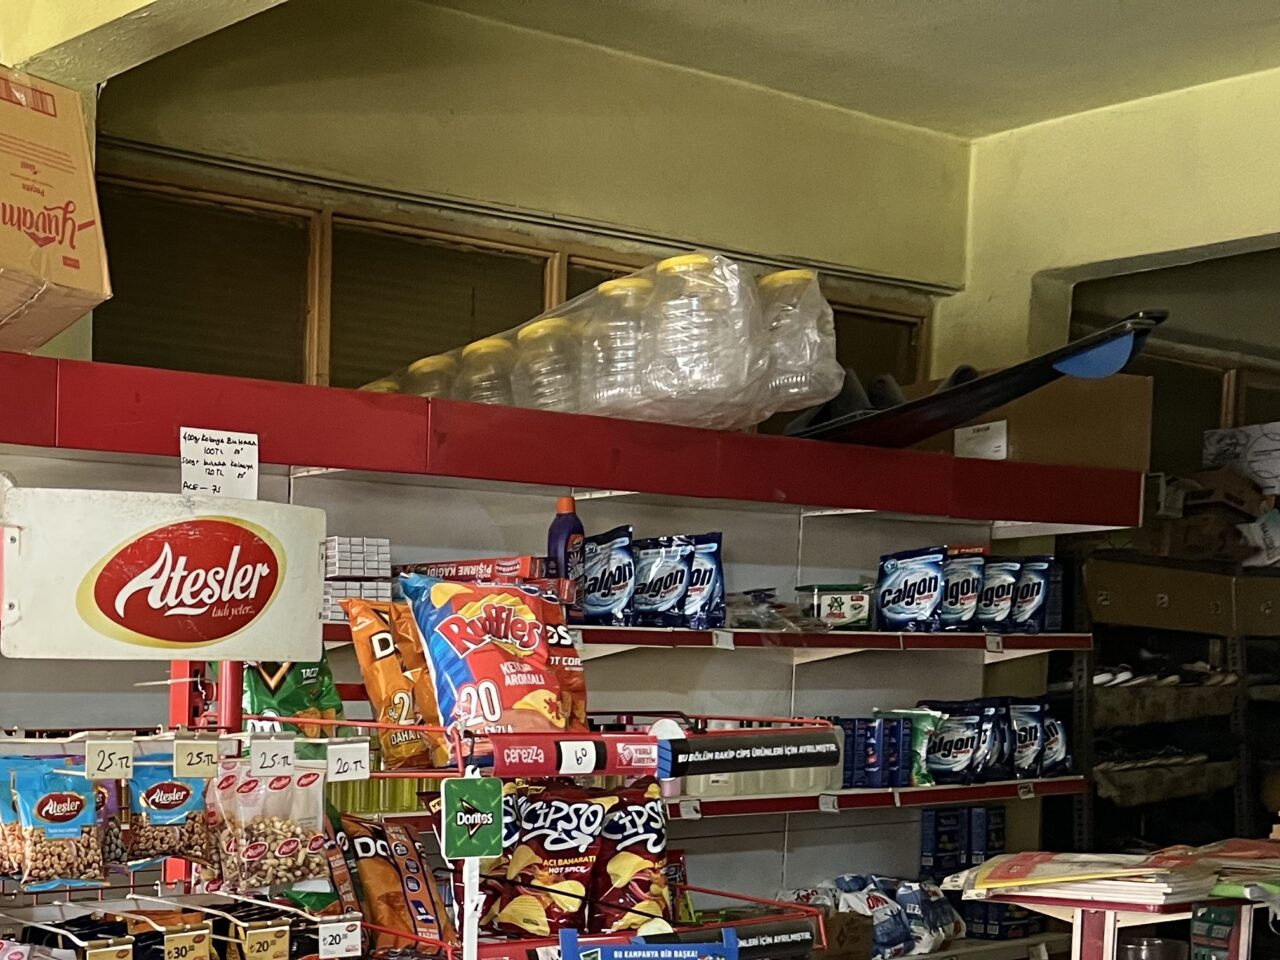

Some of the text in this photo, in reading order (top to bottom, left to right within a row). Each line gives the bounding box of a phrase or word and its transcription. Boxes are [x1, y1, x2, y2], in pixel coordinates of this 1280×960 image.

[113, 540, 271, 618] Atesler
[434, 602, 543, 659] Ruffles
[504, 673, 545, 687] AROMALI
[735, 747, 751, 759] CİPS
[148, 788, 187, 806] Atesler
[41, 798, 81, 817] Atesler
[456, 811, 494, 828] Doritos
